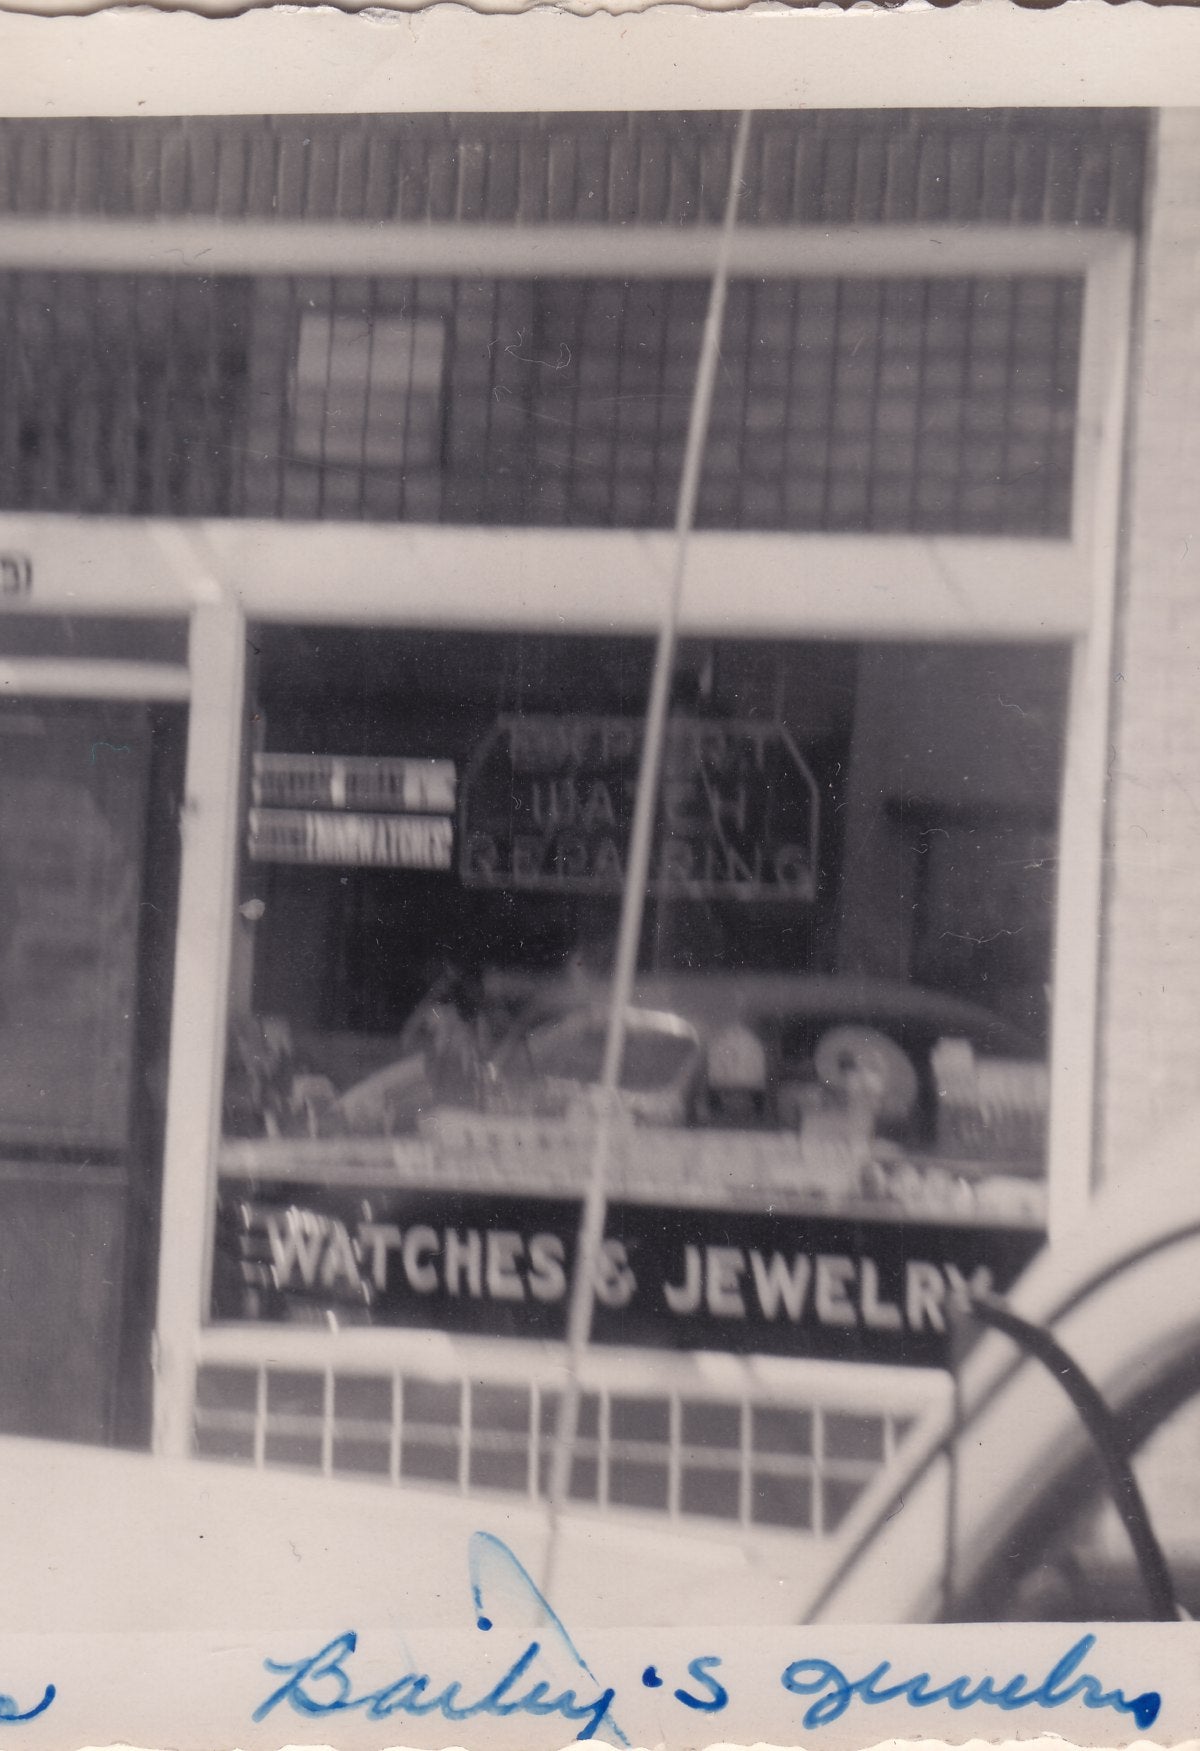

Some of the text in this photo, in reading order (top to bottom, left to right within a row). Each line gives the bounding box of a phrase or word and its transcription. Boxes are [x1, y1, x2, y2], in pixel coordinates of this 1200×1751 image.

[531, 777, 746, 833] WACH
[460, 832, 812, 893] REPARING
[266, 1210, 994, 1333] WATCHES & JEWELRY
[780, 1632, 1162, 1731] Jewelry
